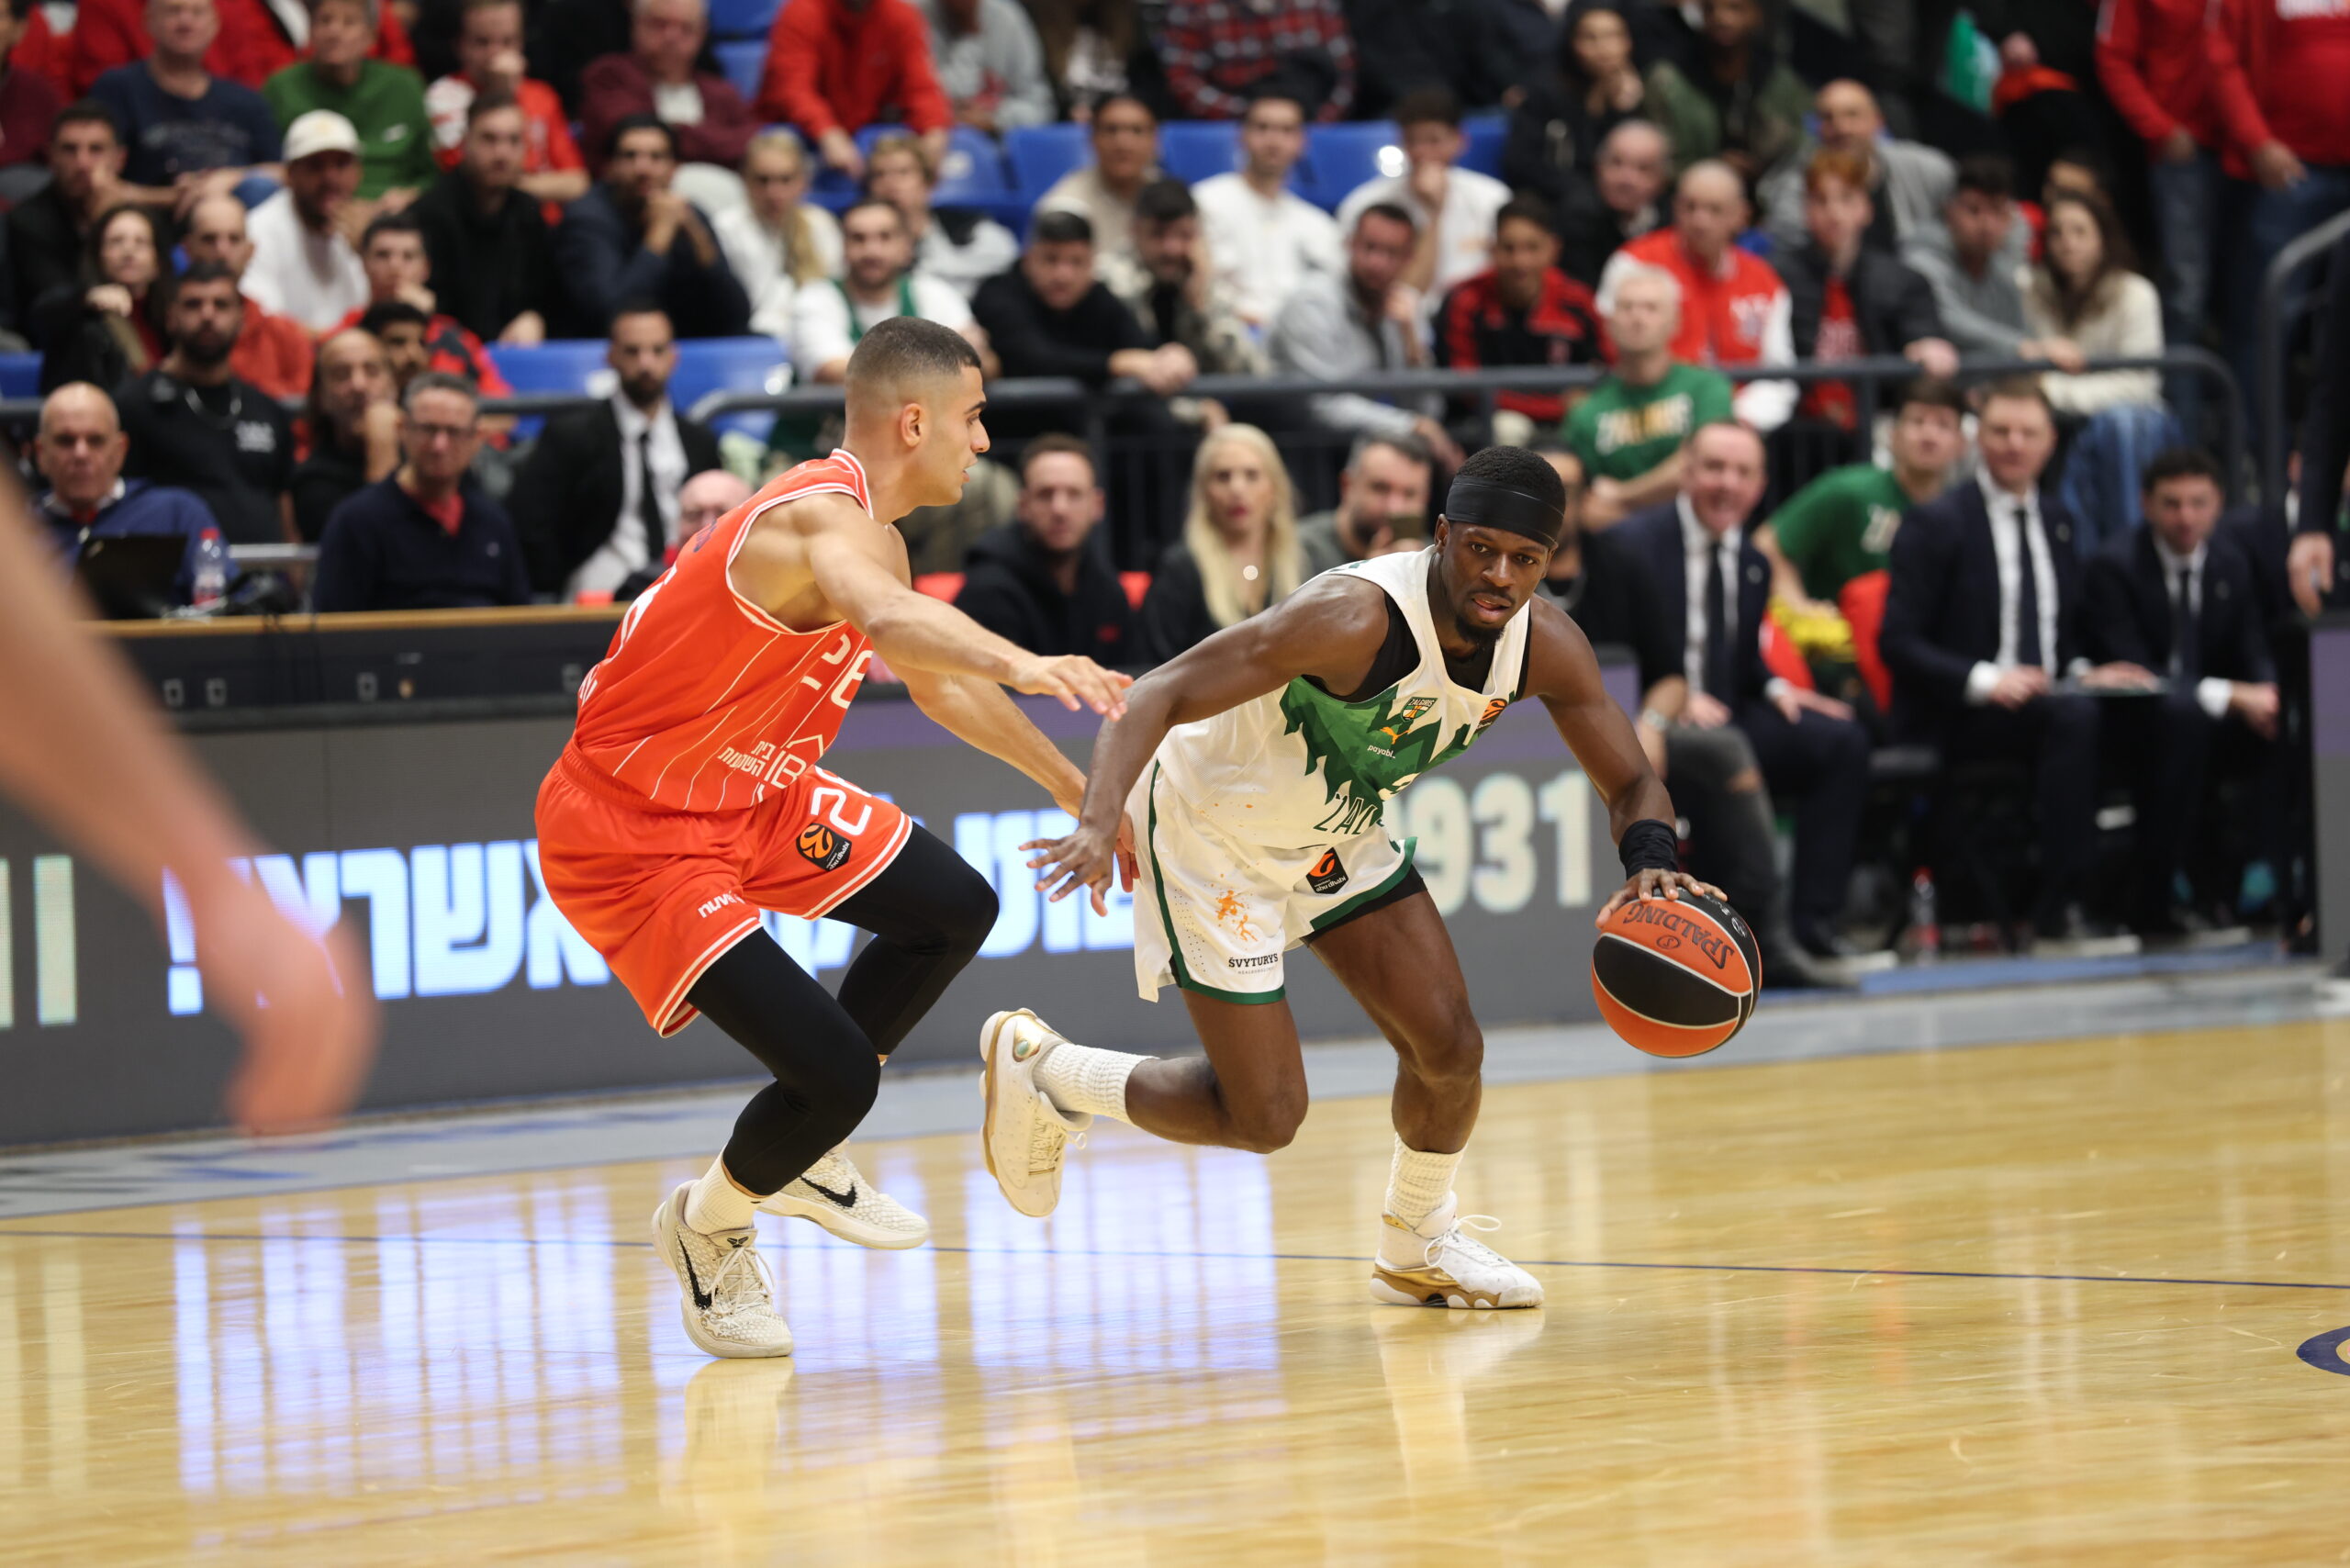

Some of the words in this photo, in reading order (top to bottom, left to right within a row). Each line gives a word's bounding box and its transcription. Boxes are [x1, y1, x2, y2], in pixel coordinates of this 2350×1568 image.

[1382, 768, 1591, 917] 931
[1228, 953, 1279, 968] ŠVYTURYS
[1623, 902, 1735, 969] SPALDING
